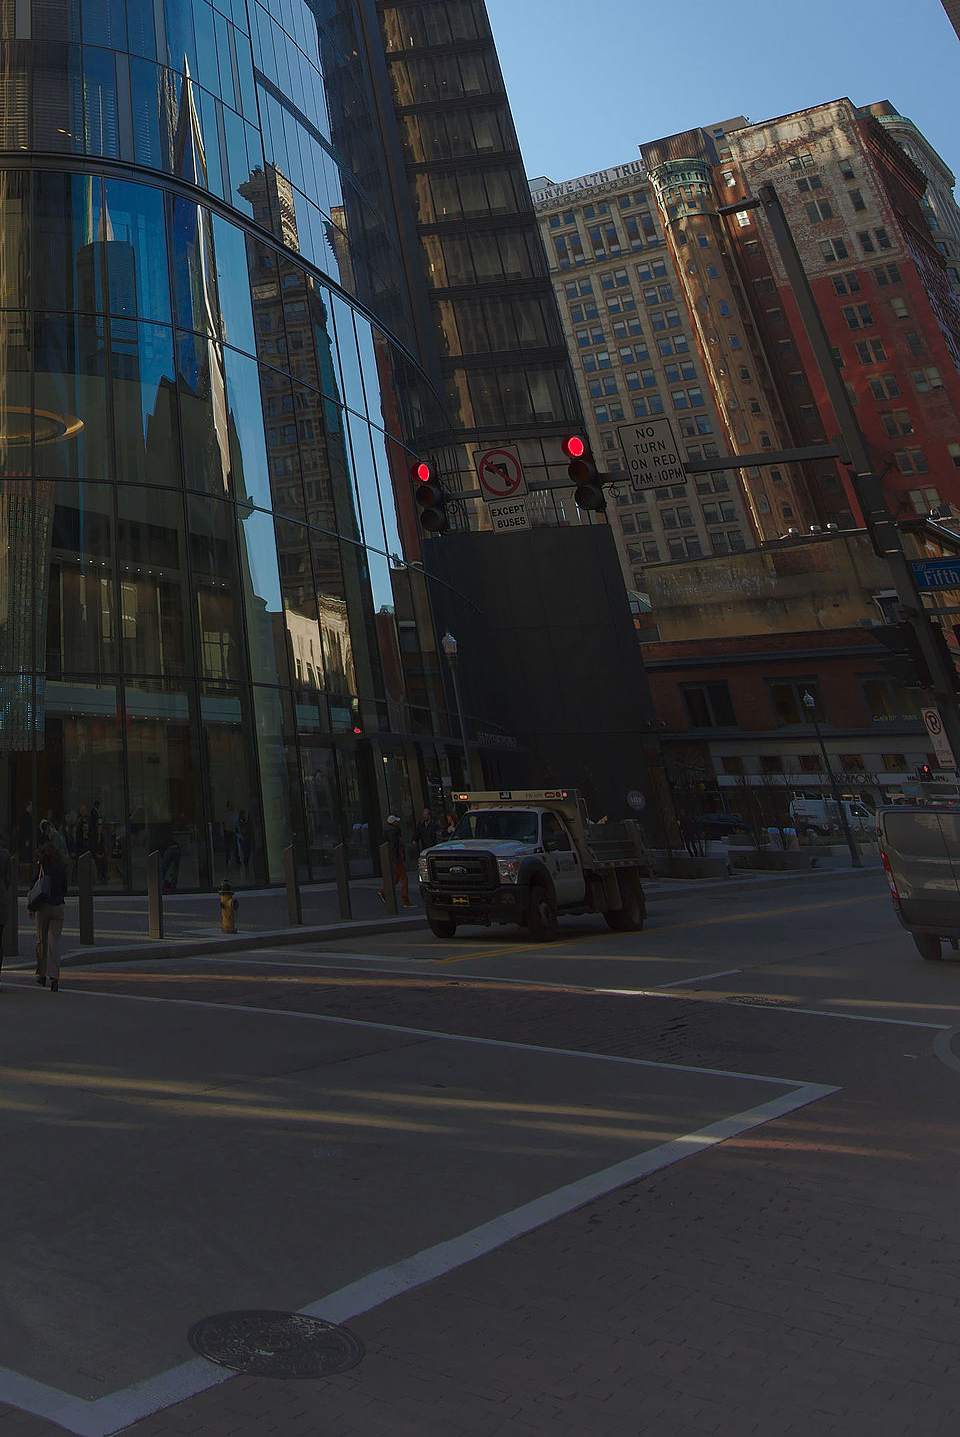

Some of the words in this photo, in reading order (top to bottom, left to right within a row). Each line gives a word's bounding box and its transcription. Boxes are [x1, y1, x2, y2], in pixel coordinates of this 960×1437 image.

[635, 426, 655, 439] NO
[633, 439, 666, 455] TURN
[631, 458, 648, 471] ON
[652, 453, 677, 467] RED
[633, 467, 683, 485] 7AM-10PM
[491, 504, 525, 517] EXCEPT
[497, 516, 527, 528] BUSES
[923, 569, 960, 586] Fifth
